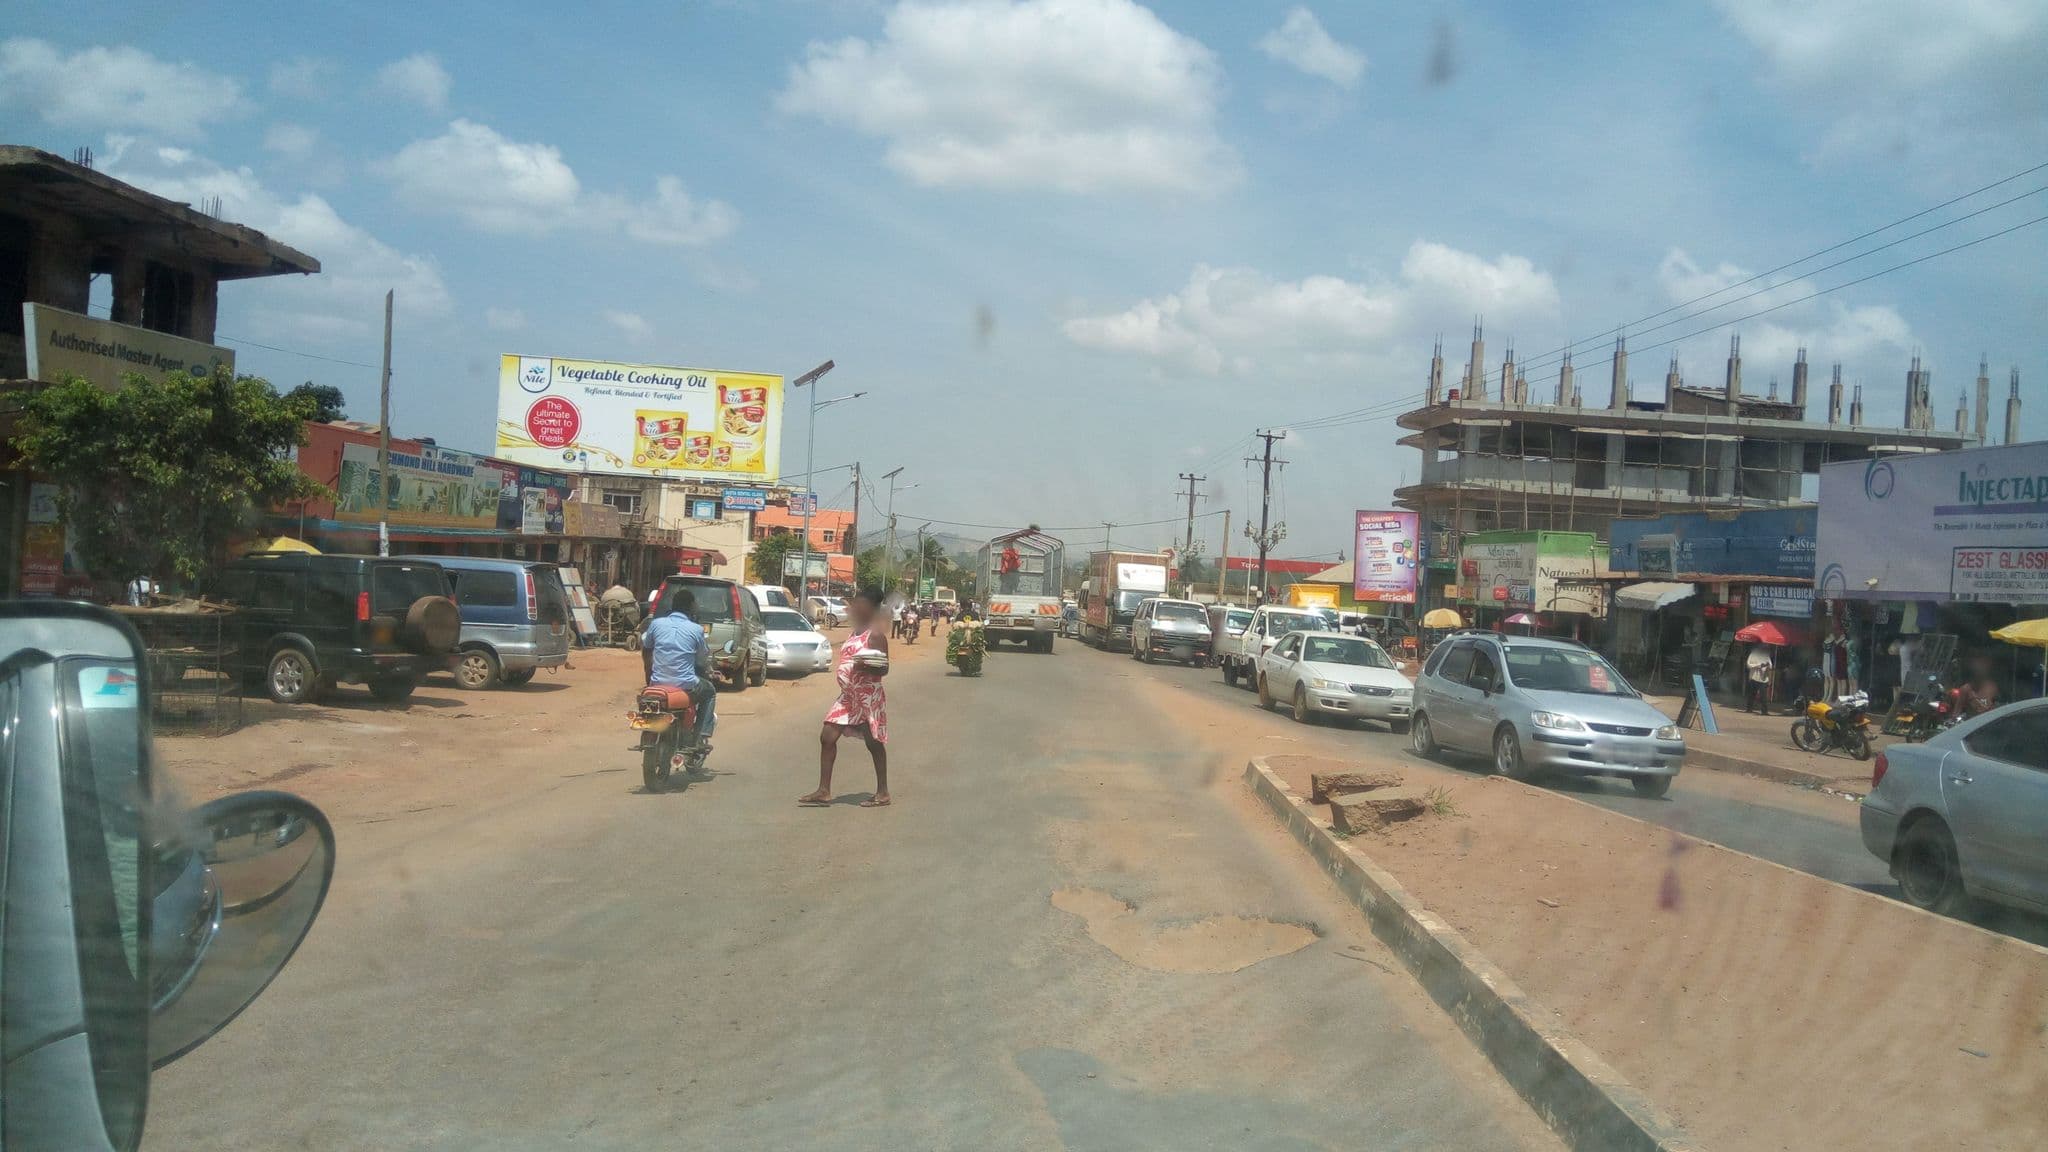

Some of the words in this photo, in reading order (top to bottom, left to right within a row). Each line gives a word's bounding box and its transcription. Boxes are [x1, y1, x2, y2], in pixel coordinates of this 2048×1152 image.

[50, 329, 115, 358] Authorised
[117, 343, 153, 365] Master
[153, 353, 185, 372] Agent
[524, 374, 546, 384] Nile
[557, 365, 625, 383] Vegetable
[627, 370, 683, 389] Cooking
[686, 374, 708, 388] Oil
[614, 388, 644, 398] Blended
[653, 391, 683, 401] Fortified
[546, 400, 562, 410] The
[536, 409, 571, 419] ultimate
[533, 416, 561, 427] Secret
[563, 419, 573, 428] to
[541, 426, 563, 436] great
[538, 434, 565, 444] meals
[386, 450, 421, 470] CHMOND
[1240, 561, 1260, 569] TOTA
[1957, 552, 1993, 569] ZEST
[1380, 591, 1413, 601] africell
[1787, 586, 1816, 600] MEDICAL
